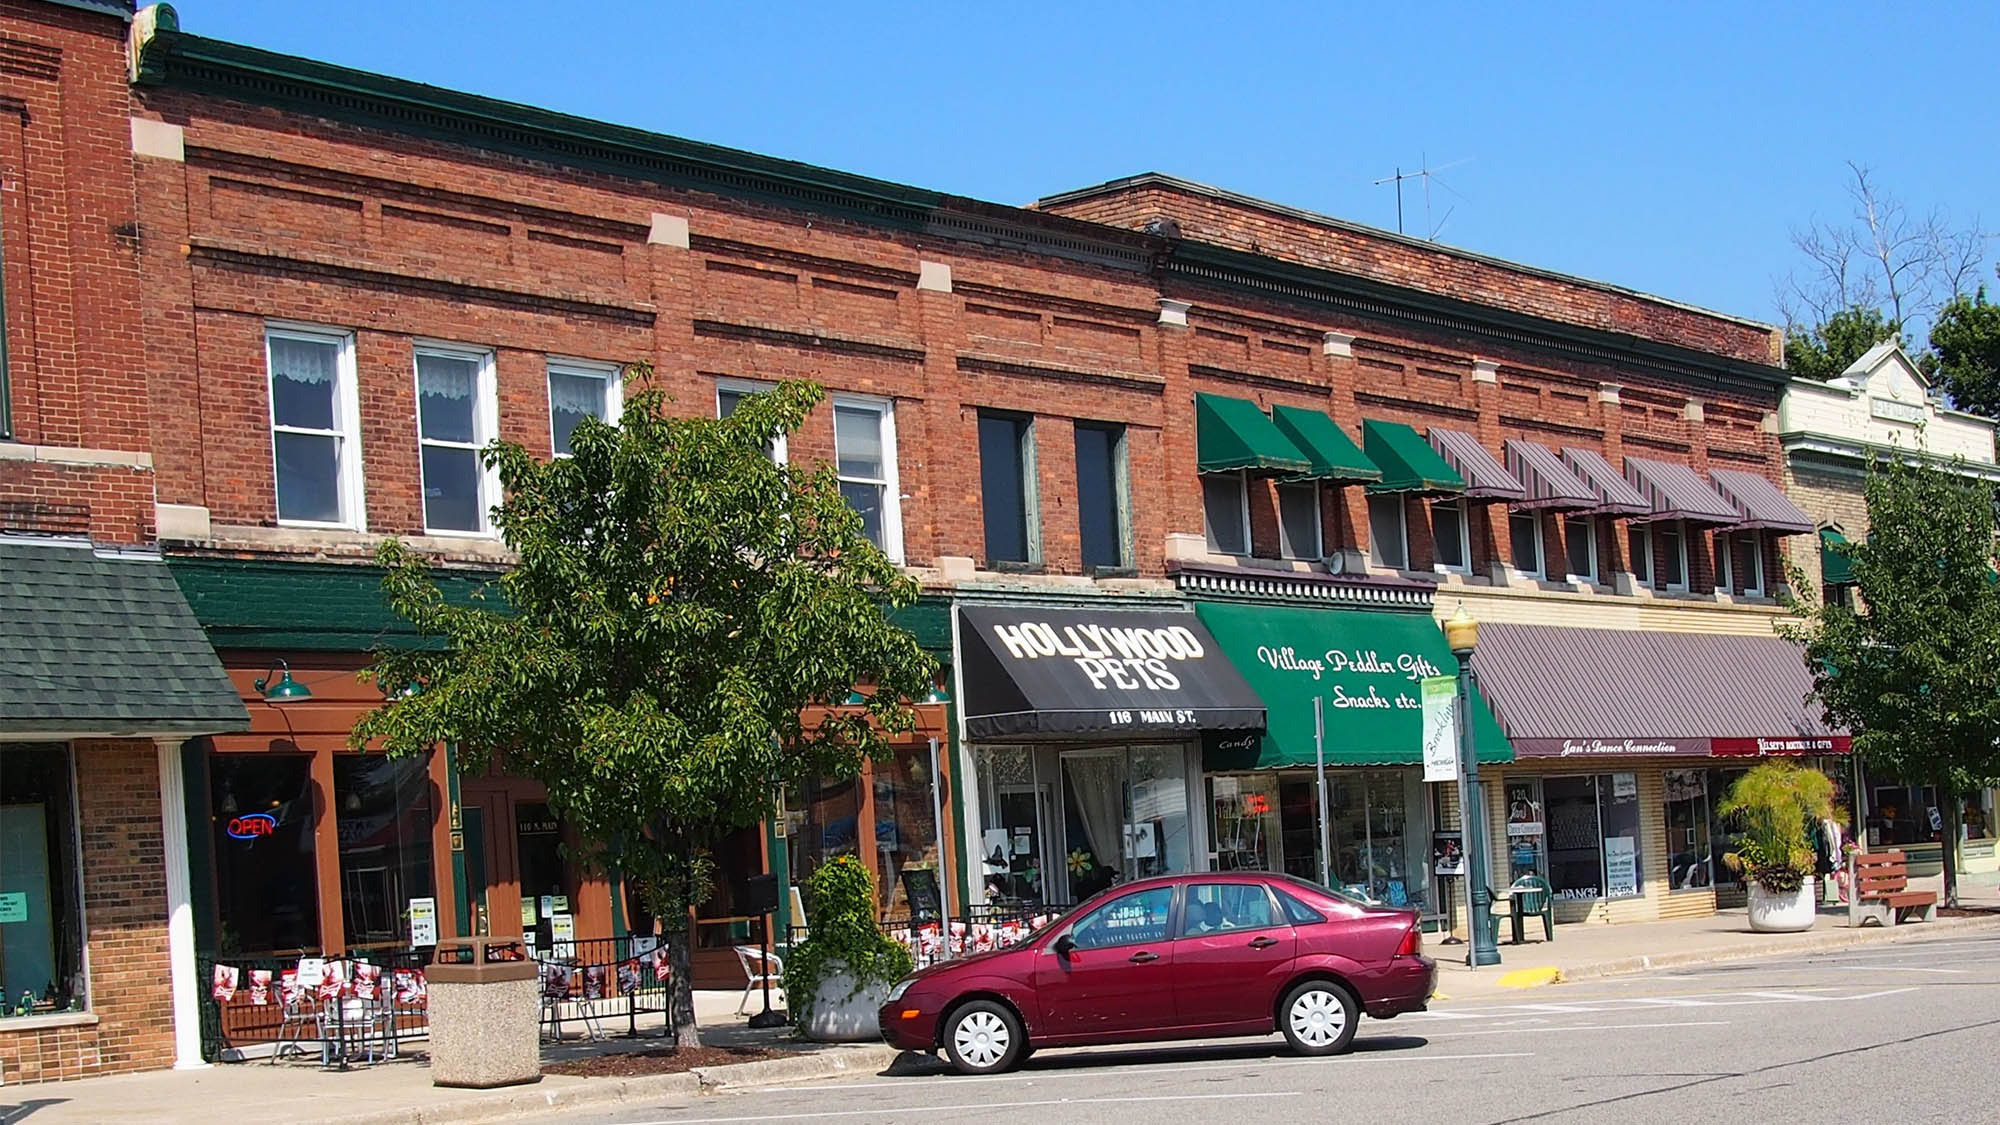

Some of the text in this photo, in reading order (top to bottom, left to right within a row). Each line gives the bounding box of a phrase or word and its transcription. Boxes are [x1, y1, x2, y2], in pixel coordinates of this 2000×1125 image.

[993, 622, 1205, 660] HOLLYWOOD
[1257, 646, 1441, 680] Village Peddler Gifts
[1073, 657, 1181, 690] PETS
[1333, 685, 1422, 709] Snacks etc.
[1109, 710, 1197, 725] 116 MAIN ST.
[1219, 735, 1255, 750] Candy
[1560, 739, 1676, 757] Jan's Dance Connection
[1512, 789, 1526, 800] 120
[228, 818, 273, 836] OPEN
